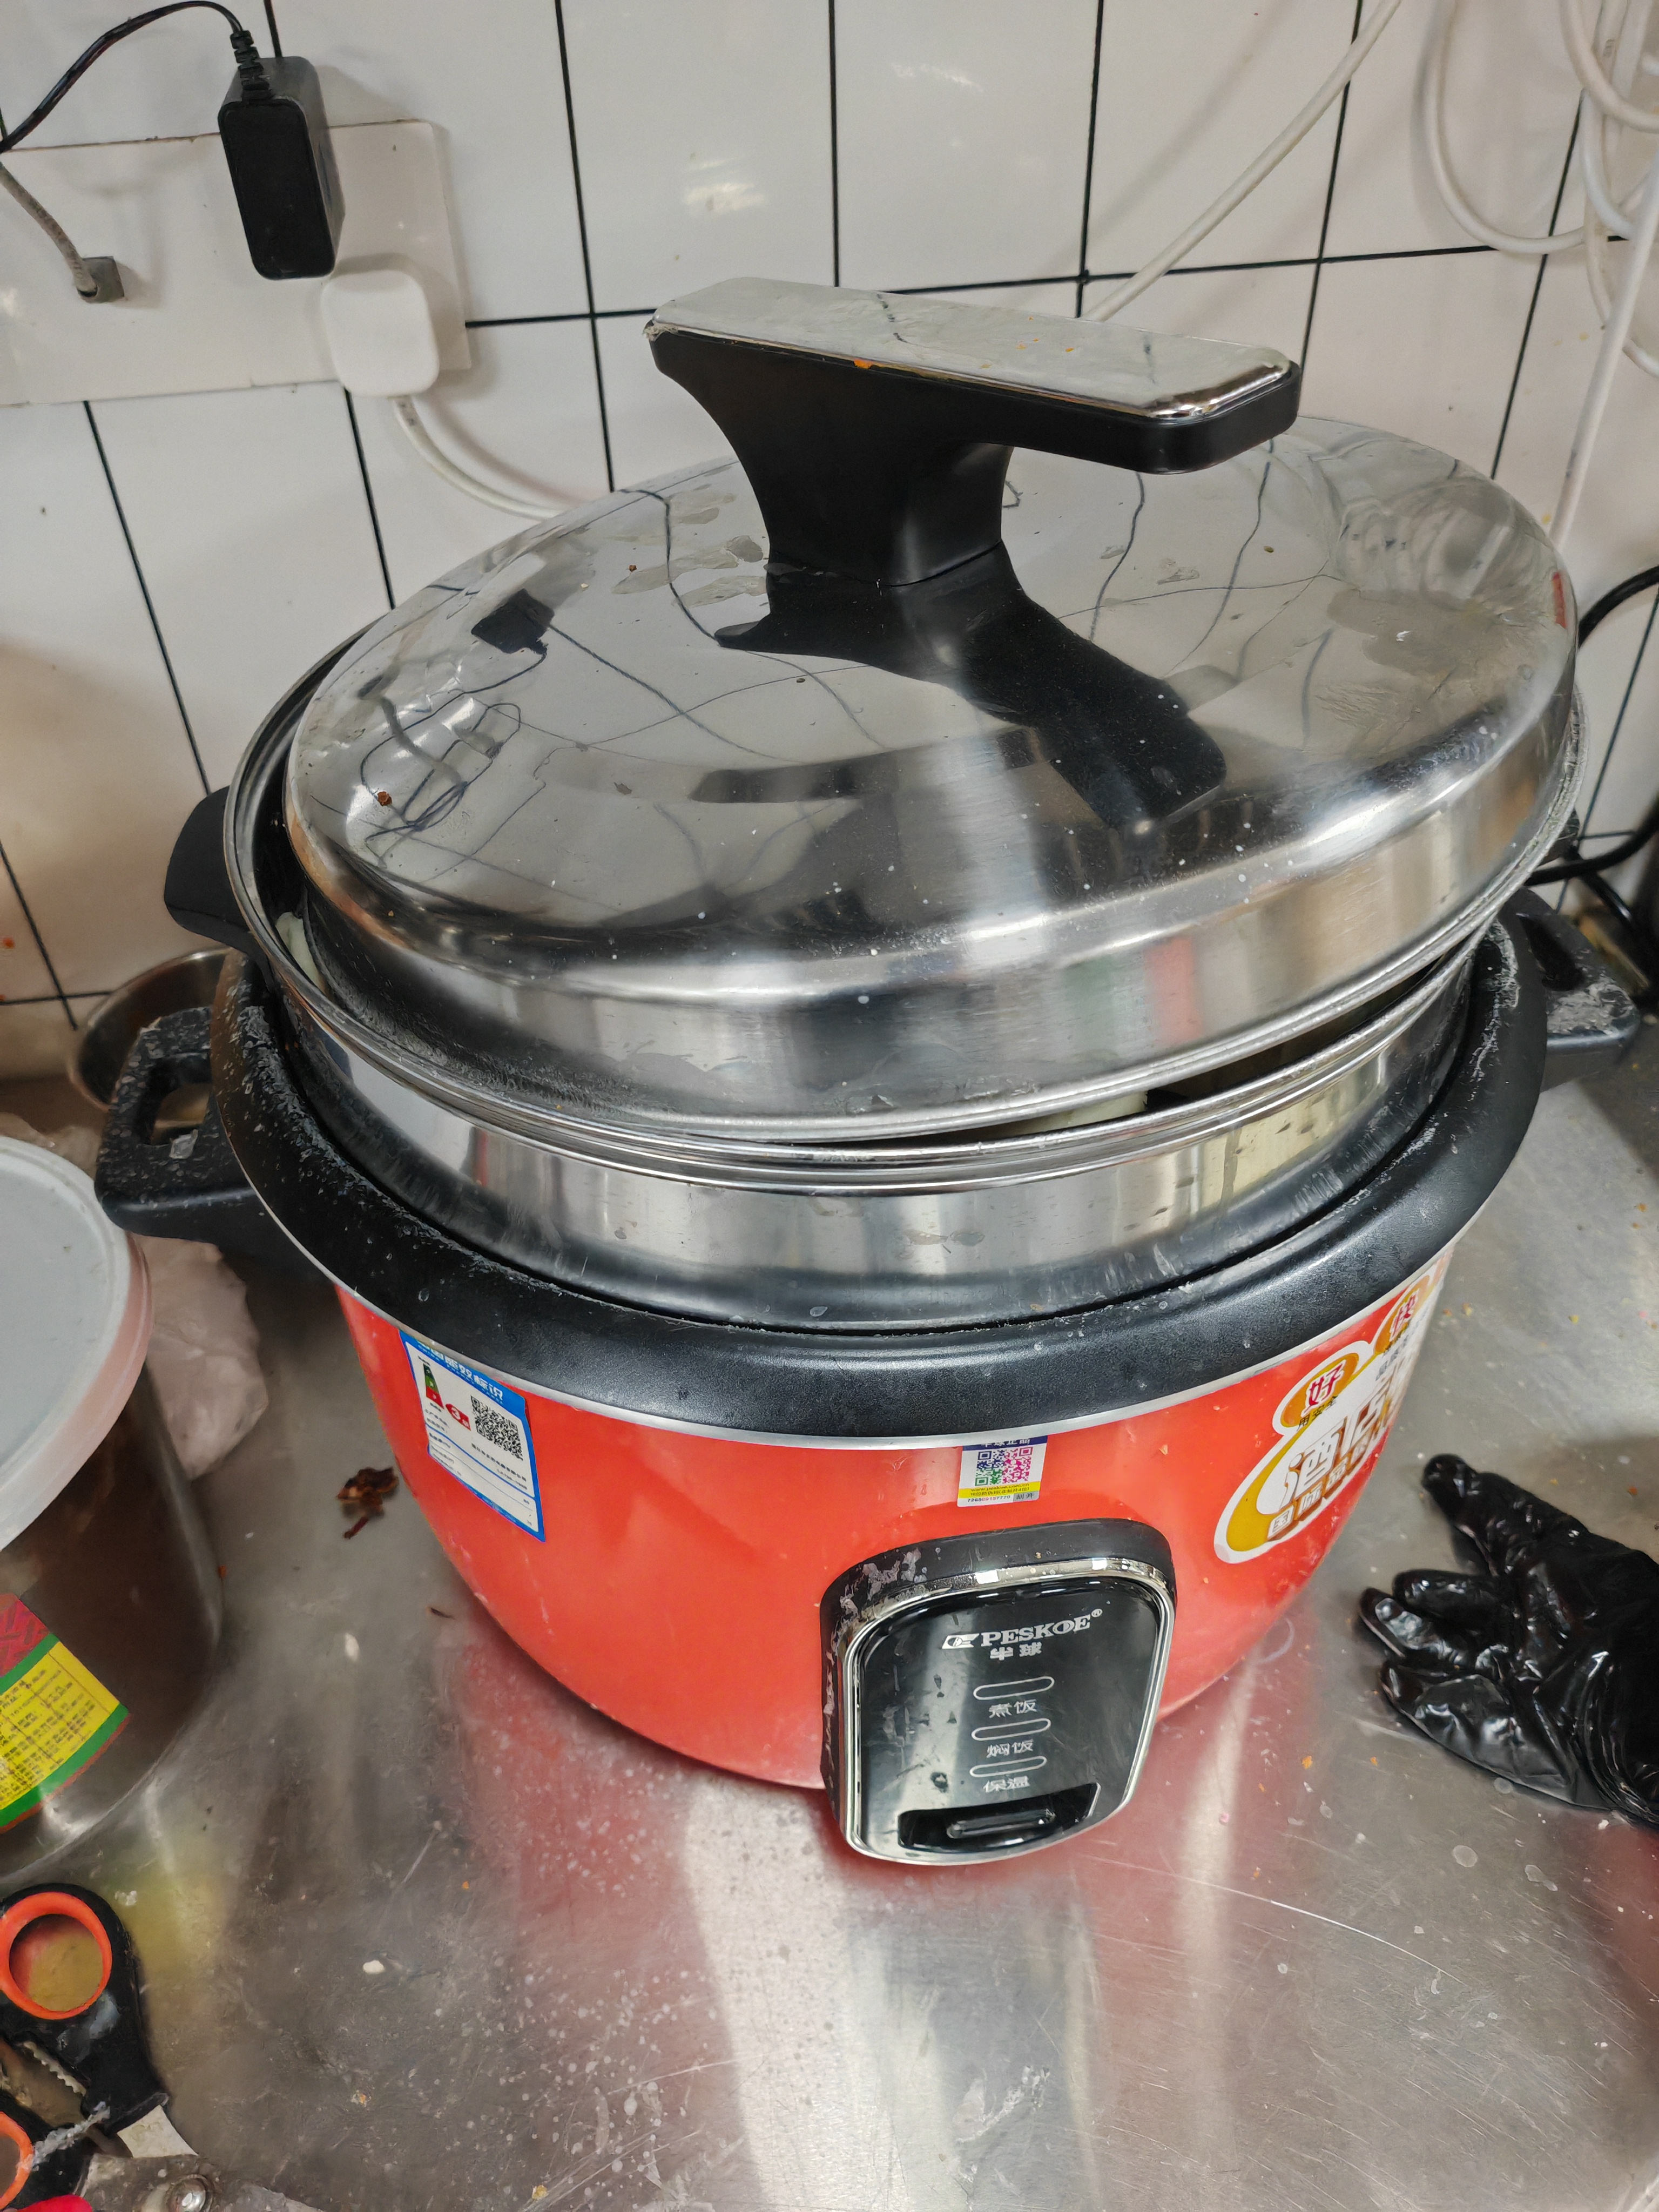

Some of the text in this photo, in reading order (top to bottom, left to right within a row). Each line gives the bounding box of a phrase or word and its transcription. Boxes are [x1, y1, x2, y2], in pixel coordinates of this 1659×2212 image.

[417, 1340, 503, 1400] 国能效标识
[1301, 1360, 1346, 1417] 好
[989, 1641, 1042, 1661] 半球
[988, 1699, 1037, 1718] 煮饭
[987, 1739, 1034, 1759] 焖饭
[983, 1775, 1031, 1793] 保温
